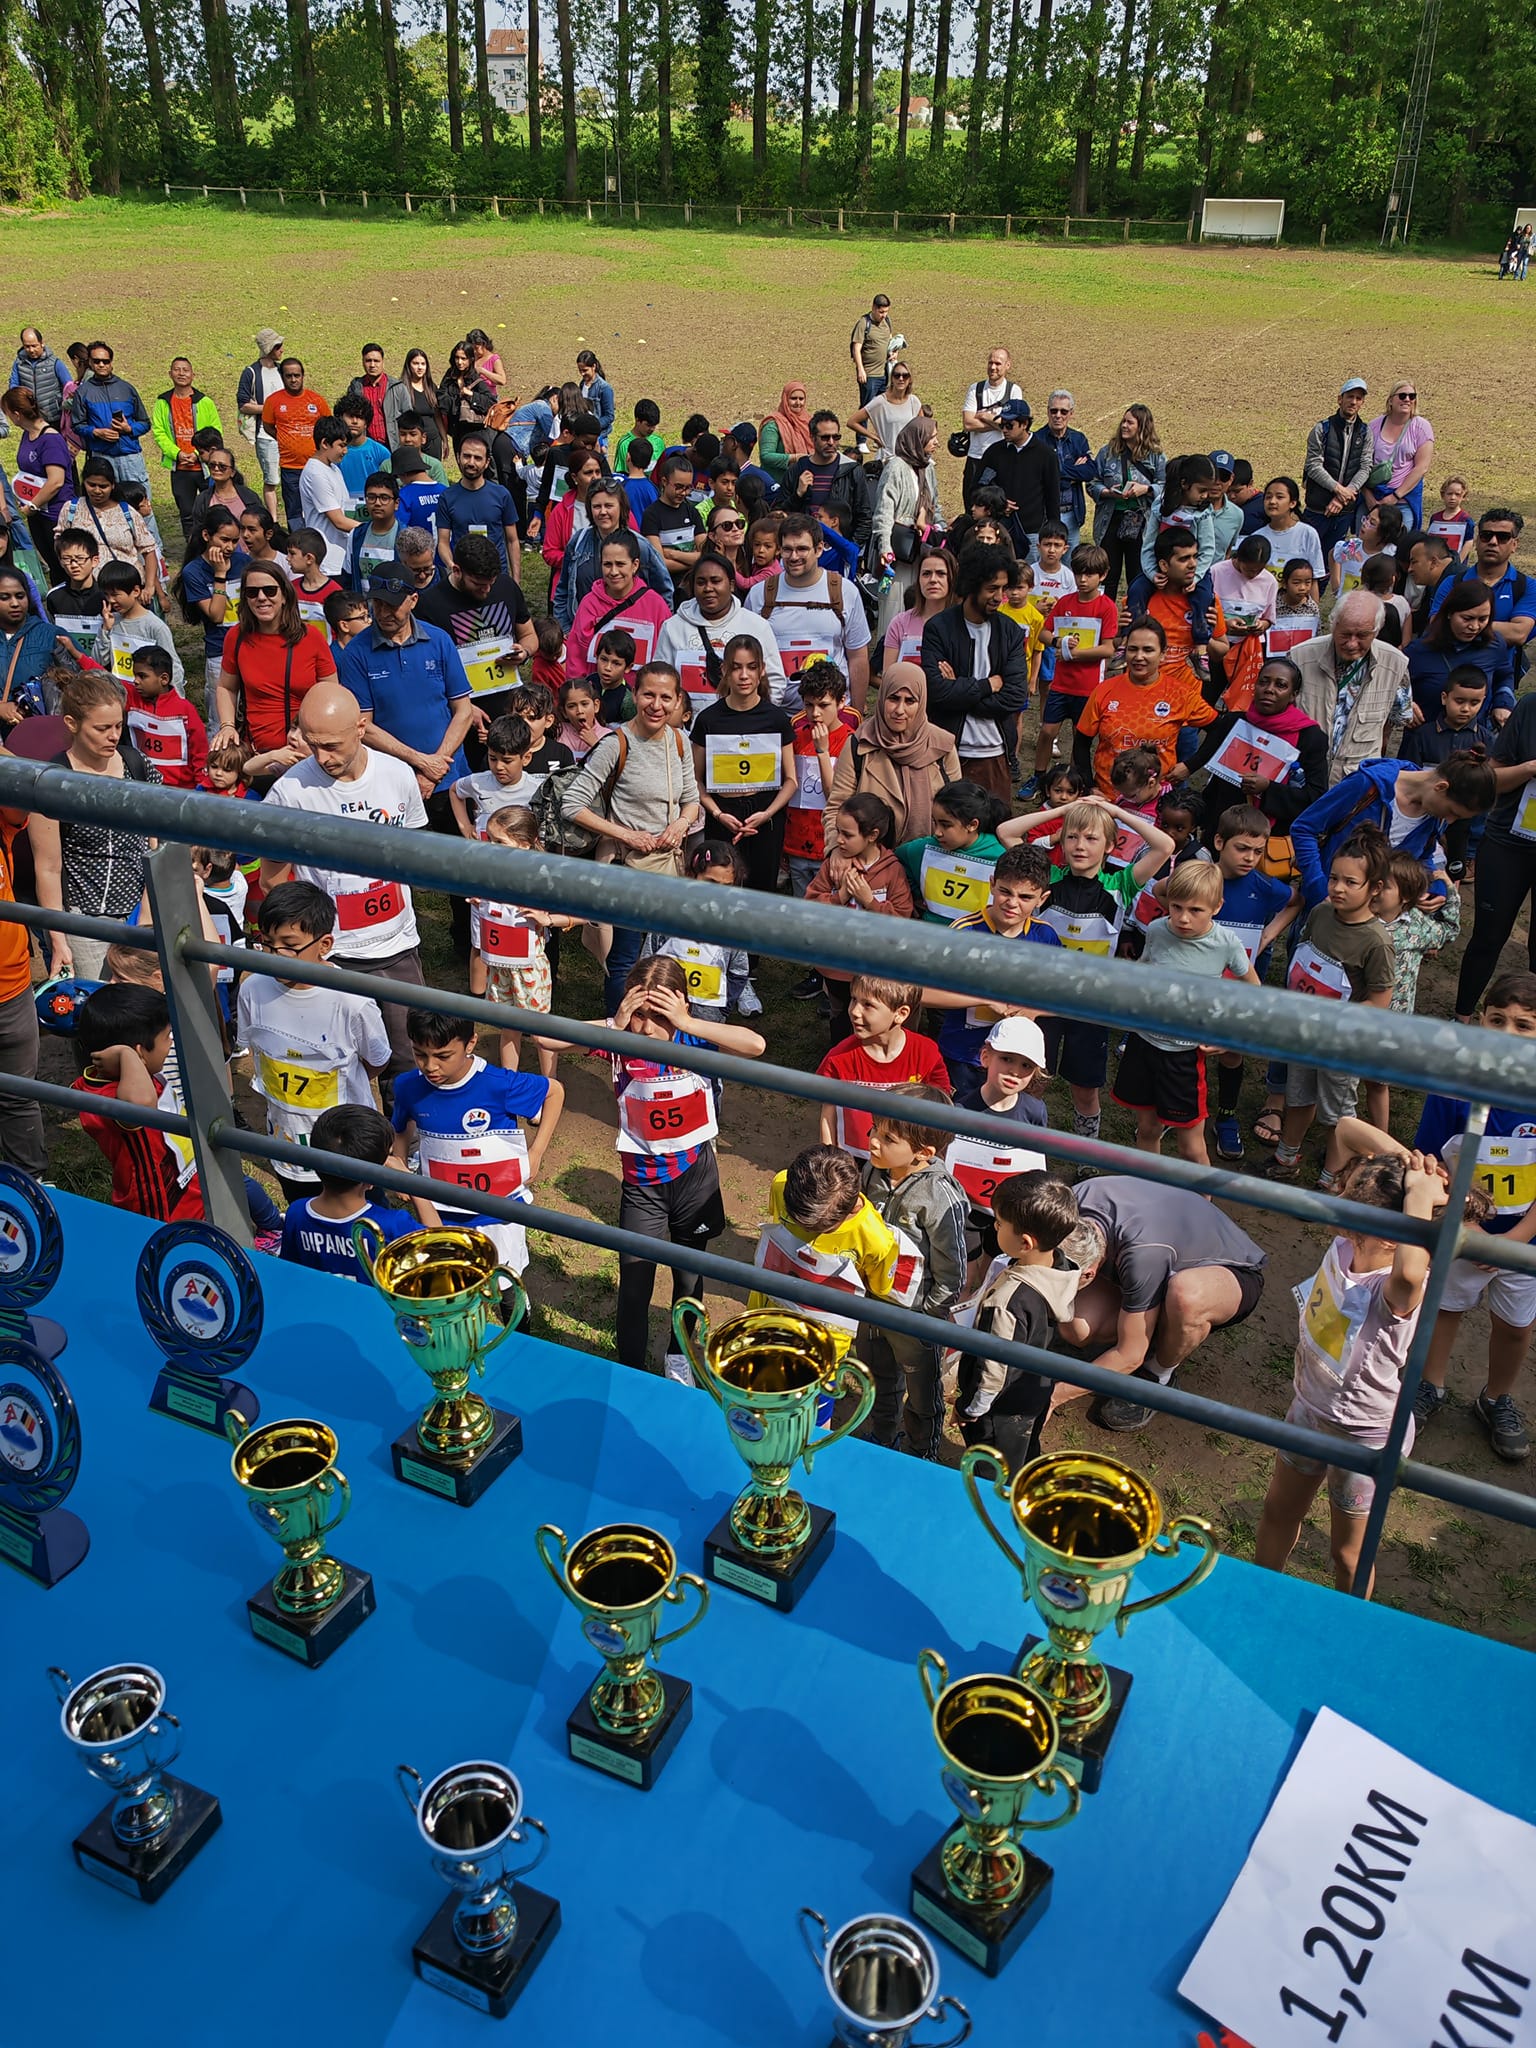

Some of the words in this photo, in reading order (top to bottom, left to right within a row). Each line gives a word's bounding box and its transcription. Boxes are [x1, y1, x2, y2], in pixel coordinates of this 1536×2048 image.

[22, 485, 33, 497] 34
[418, 494, 440, 506] BIVAS
[357, 508, 370, 517] 16
[78, 638, 96, 650] 35
[117, 657, 132, 670] 49
[485, 664, 504, 681] 13
[144, 737, 163, 753] 48
[738, 760, 750, 775] 9
[1243, 751, 1263, 772] 13
[803, 774, 824, 795] 60
[341, 800, 373, 814] REAL
[942, 879, 970, 900] 57
[364, 893, 391, 916] 66
[489, 929, 500, 946] 5
[688, 970, 702, 987] 6
[278, 1072, 310, 1096] 17
[649, 1106, 684, 1131] 65
[1490, 1147, 1509, 1156] 3KM
[457, 1172, 491, 1193] 50
[979, 1179, 997, 1198] 2
[1481, 1173, 1515, 1196] 11
[1279, 1789, 1428, 2043] 1,20KM
